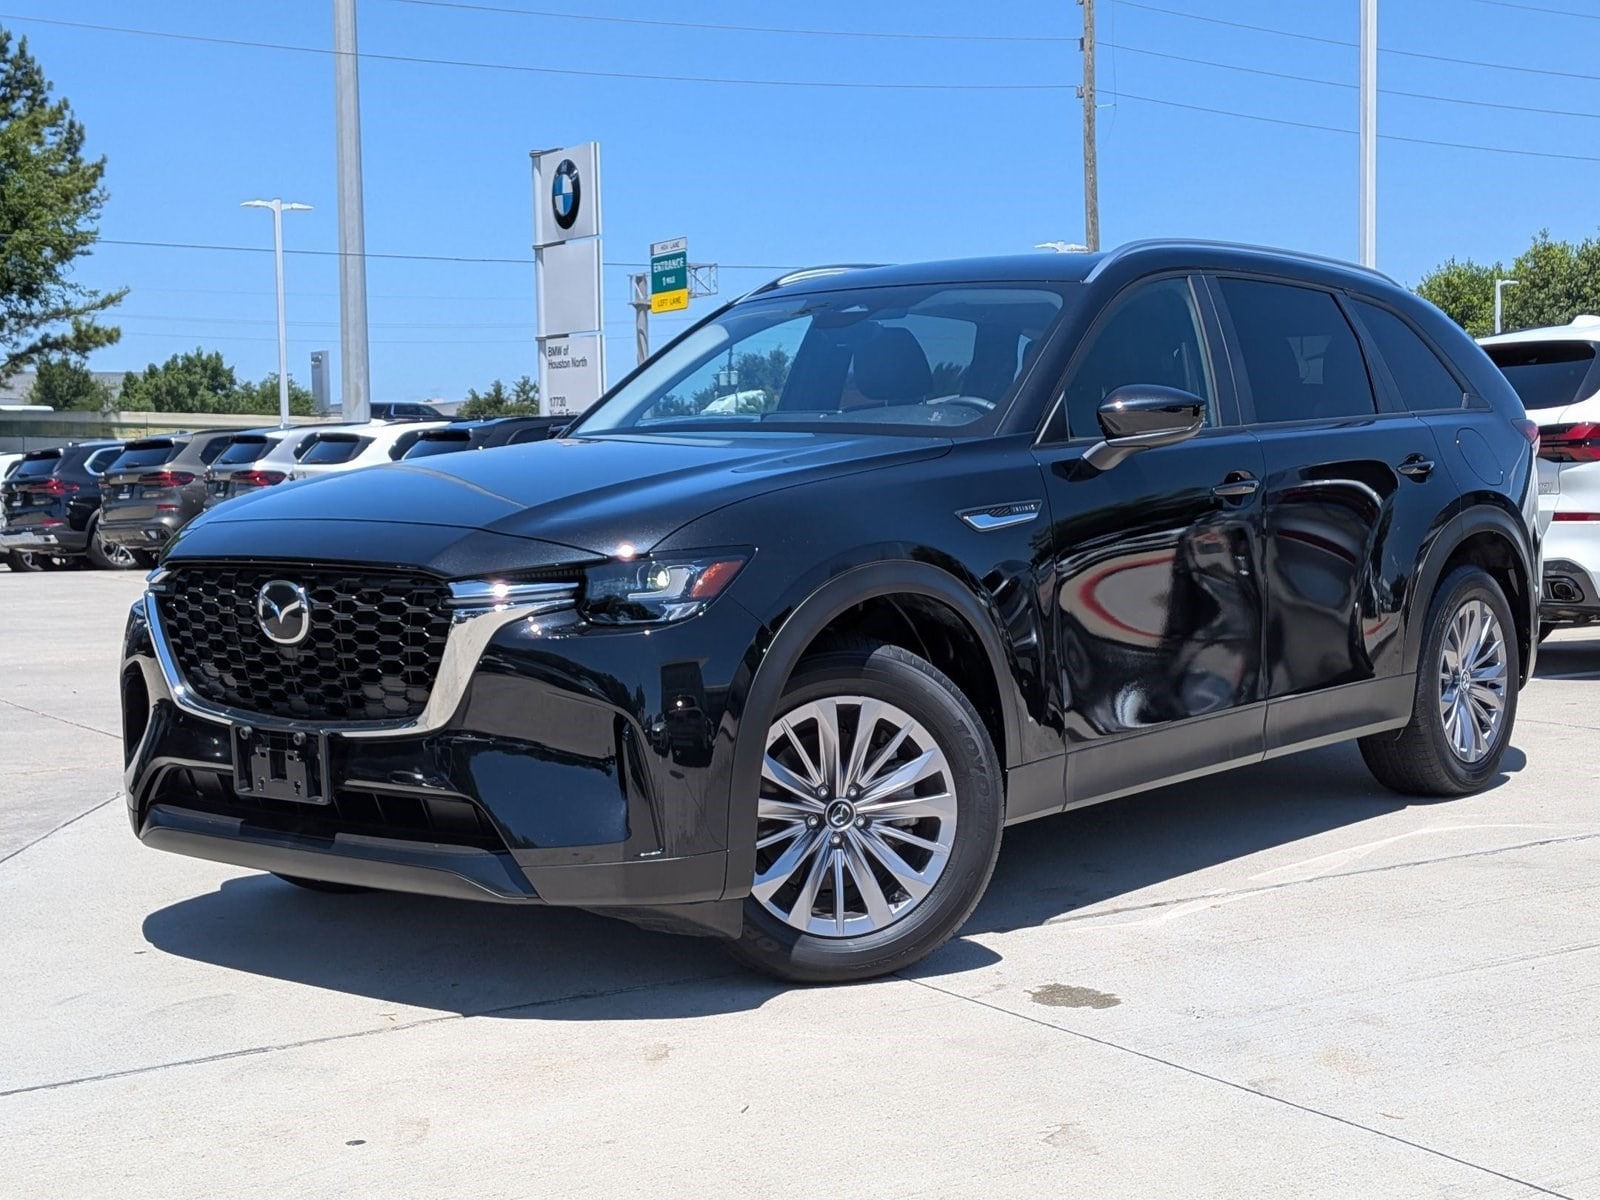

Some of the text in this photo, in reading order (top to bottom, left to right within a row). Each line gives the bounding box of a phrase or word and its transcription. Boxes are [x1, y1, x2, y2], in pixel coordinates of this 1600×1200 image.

[653, 257, 684, 273] ENTRANCE
[657, 296, 682, 307] LEFT LANE
[548, 345, 569, 357] BMW of
[548, 356, 588, 369] Houston North
